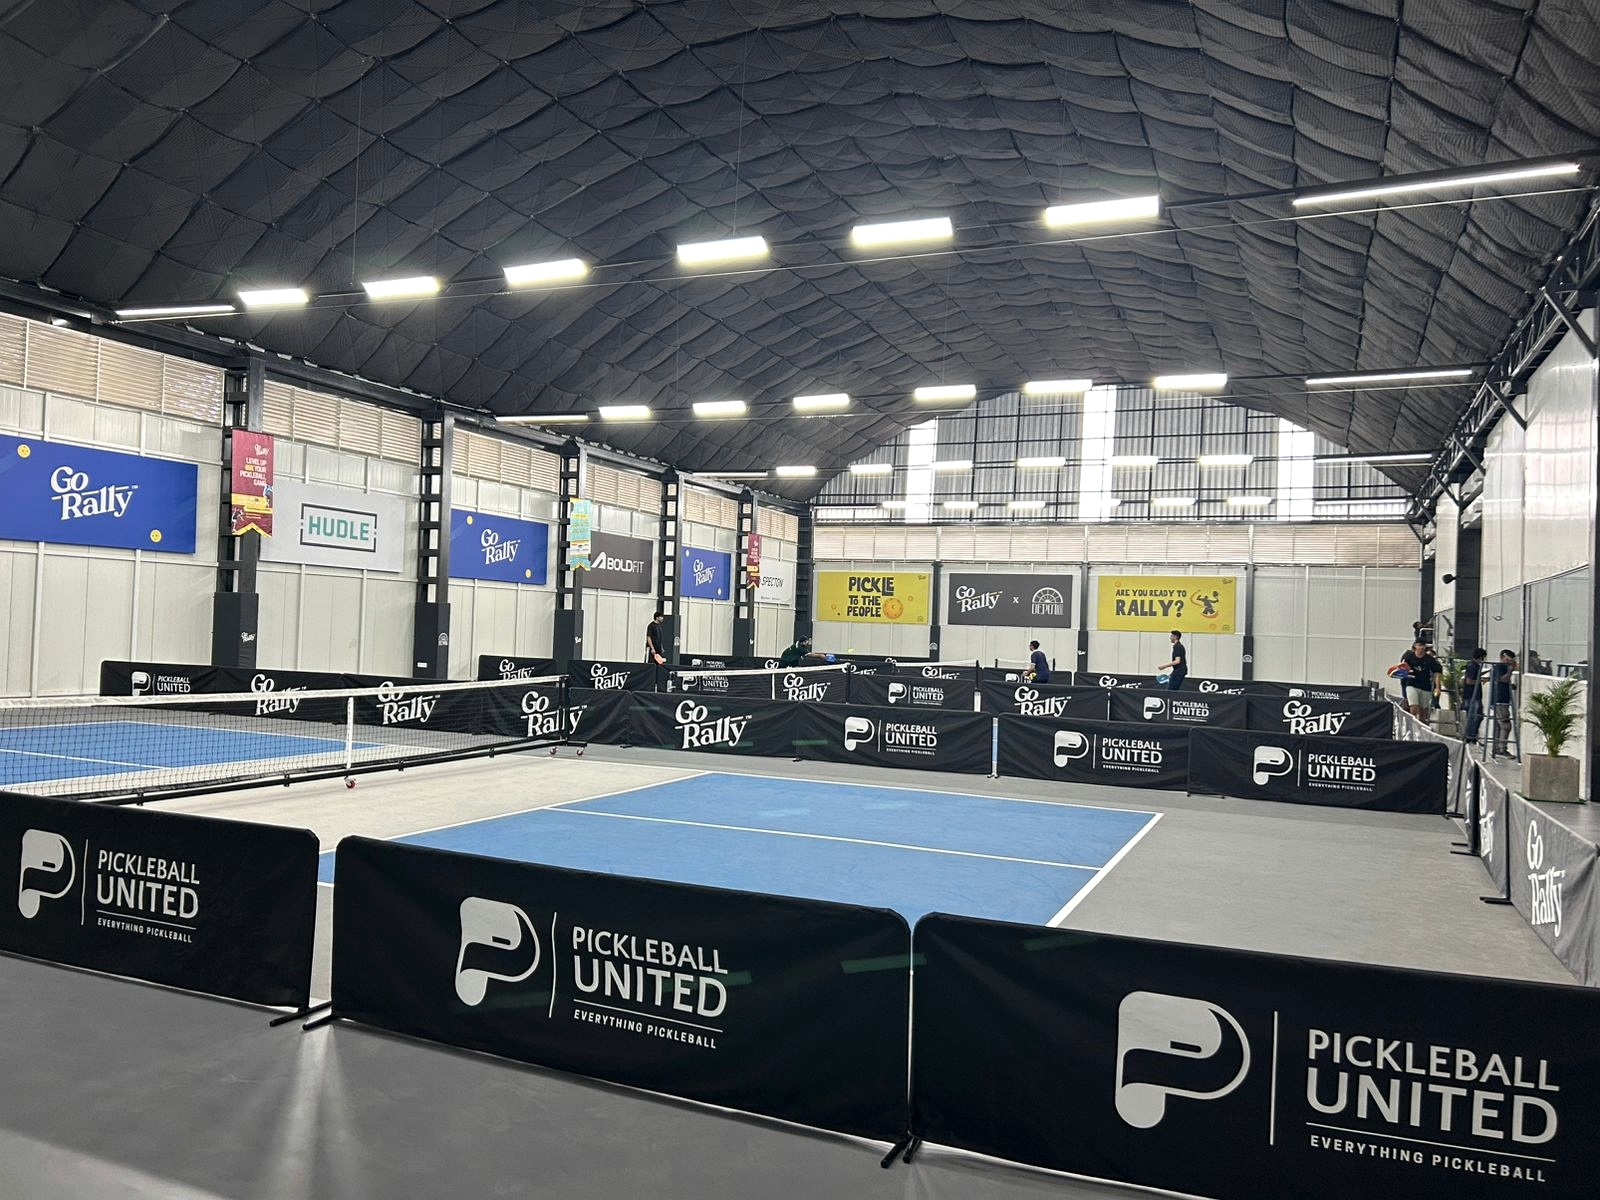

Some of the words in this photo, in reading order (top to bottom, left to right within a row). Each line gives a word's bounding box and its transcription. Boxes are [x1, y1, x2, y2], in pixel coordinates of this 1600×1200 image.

[51, 466, 89, 493] Go
[308, 515, 369, 541] HUDLE
[481, 528, 498, 547] Go
[607, 557, 644, 573] BOLDFIT
[693, 559, 703, 572] Go
[849, 577, 894, 596] PICKLE
[956, 585, 976, 599] Go
[1116, 589, 1129, 597] ARE
[861, 595, 881, 606] THE
[1115, 599, 1184, 617] RALLY?
[847, 606, 881, 617] PEOPLE
[499, 659, 515, 672] Go
[590, 663, 608, 677] Go
[765, 659, 779, 669] Go
[922, 666, 938, 678] Go
[157, 675, 190, 684] PICKLEBALL
[251, 673, 274, 693] Go
[783, 673, 803, 688] Go
[1099, 675, 1117, 687] Go
[1199, 681, 1219, 693] Go
[157, 683, 191, 693] UNITED
[912, 686, 944, 694] PICKLEBALL
[1014, 686, 1040, 702] Go
[521, 691, 549, 713] Go
[912, 692, 944, 701] UNITED
[675, 700, 708, 724] Go
[1172, 701, 1209, 709] PICKLEBALL
[1172, 707, 1209, 717] UNITED
[1283, 700, 1312, 718] Go
[886, 723, 938, 735] PICKLEBALL
[885, 731, 938, 747] UNITED
[1102, 737, 1163, 750] PICKLEBALL
[1102, 747, 1162, 764] UNITED
[1308, 753, 1376, 767] PICKLEBALL
[1308, 764, 1376, 782] UNITED
[1527, 820, 1543, 869] Go
[98, 849, 200, 885] PICKLEBALL
[97, 873, 199, 919] UNITED
[97, 917, 144, 934] EVERYTHING
[146, 926, 192, 943] PICKLEBALL
[572, 926, 728, 974] PICKLEBALL
[573, 955, 727, 1018] UNITED
[573, 1009, 643, 1033] EVERYTHING
[646, 1024, 717, 1049] PICKLEBALL
[1308, 1028, 1560, 1091] PICKLEBALL
[1306, 1067, 1558, 1144] UNITED
[1310, 1134, 1424, 1165] EVERYTHING
[1432, 1153, 1546, 1183] PICKLEBALL
